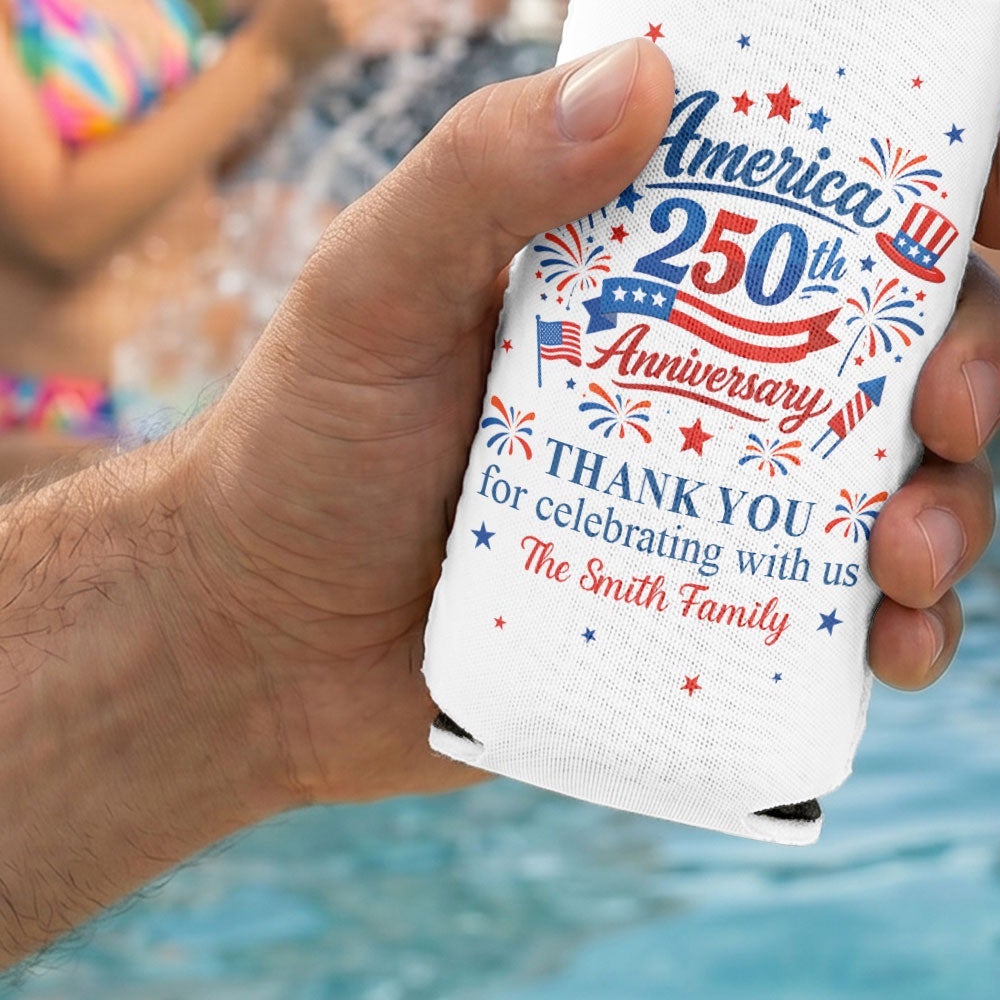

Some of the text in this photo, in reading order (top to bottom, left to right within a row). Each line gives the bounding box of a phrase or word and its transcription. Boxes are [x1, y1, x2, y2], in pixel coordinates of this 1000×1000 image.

[659, 90, 891, 228] America
[633, 198, 847, 305] 250th
[586, 324, 831, 434] Anniversary
[477, 464, 859, 587] for celebrating with us
[546, 438, 816, 537] THANK YOU
[520, 535, 790, 646] The Smith Family
